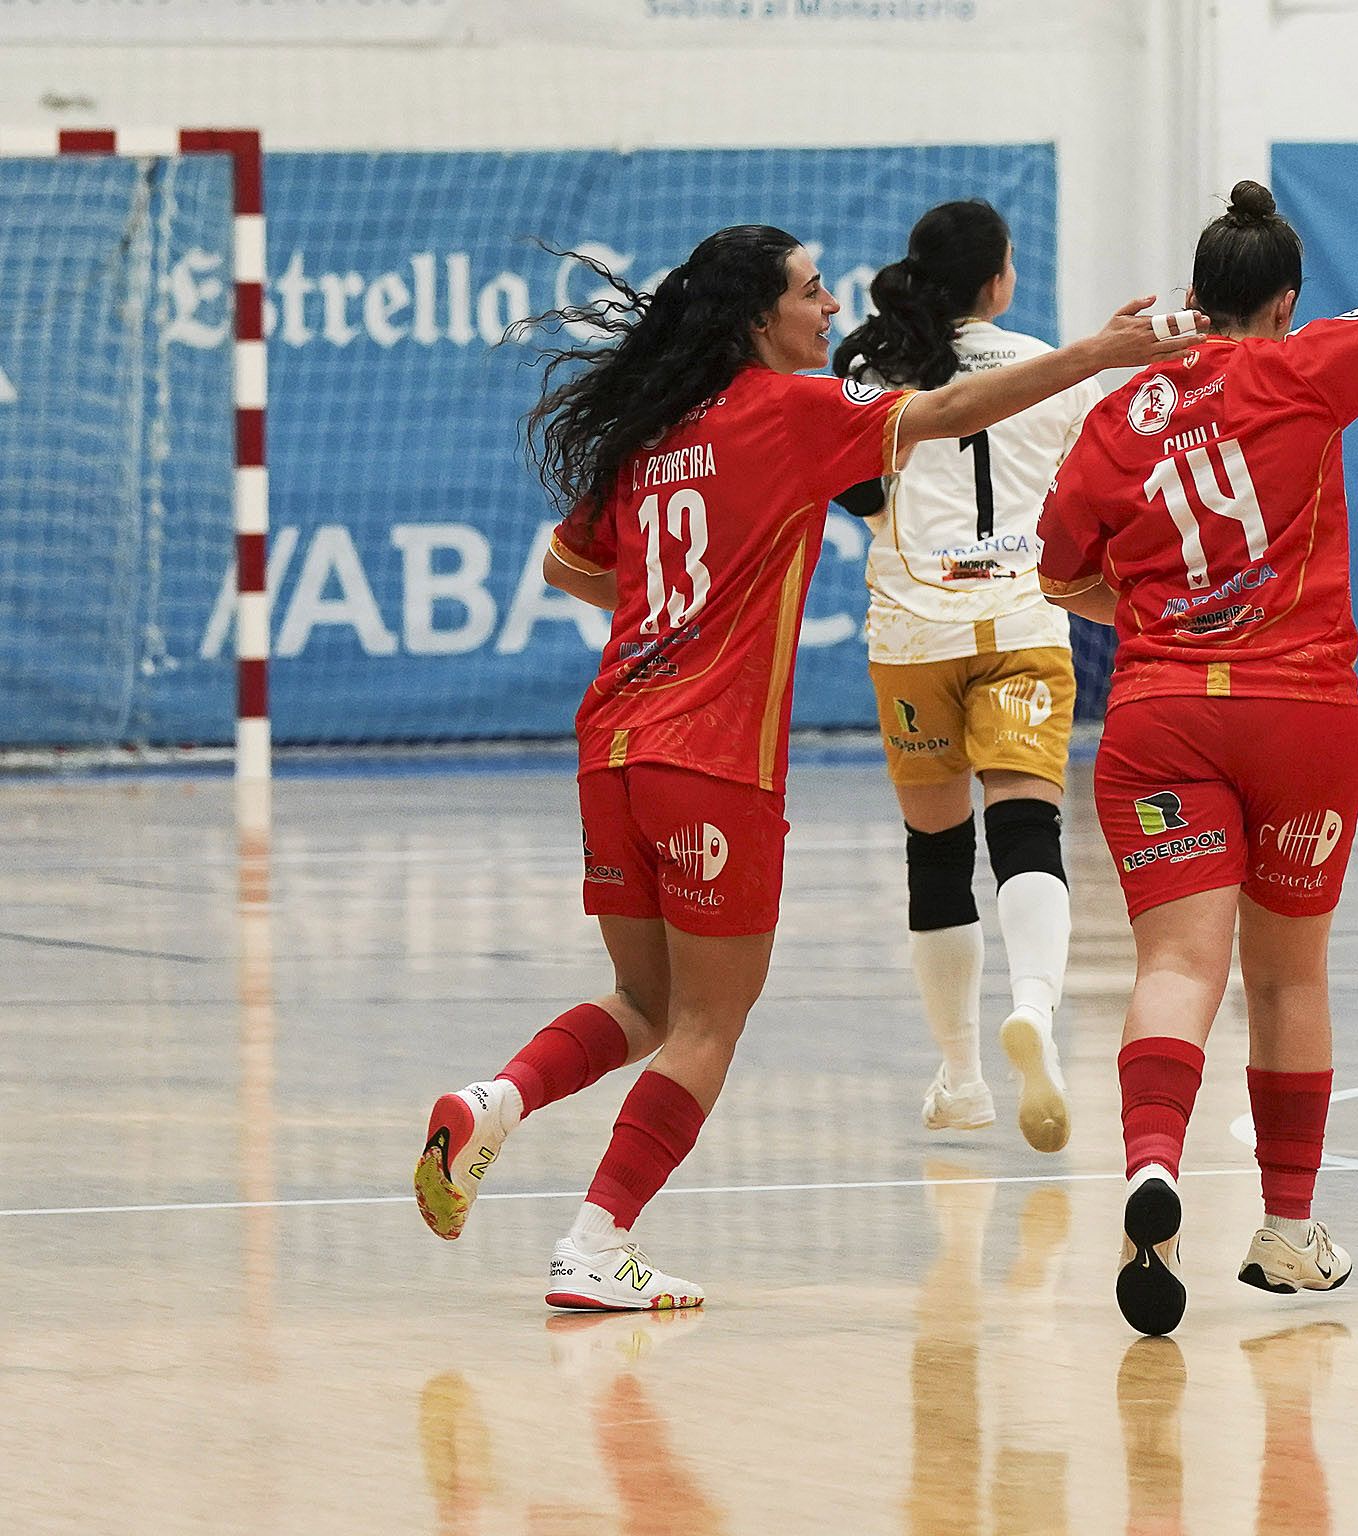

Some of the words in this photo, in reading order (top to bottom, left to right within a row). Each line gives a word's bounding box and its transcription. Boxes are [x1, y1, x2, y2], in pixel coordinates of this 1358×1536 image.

[644, 443, 717, 487] PEDREIRA
[959, 429, 994, 541] 1
[1143, 438, 1269, 590] 14
[638, 488, 711, 635] 13
